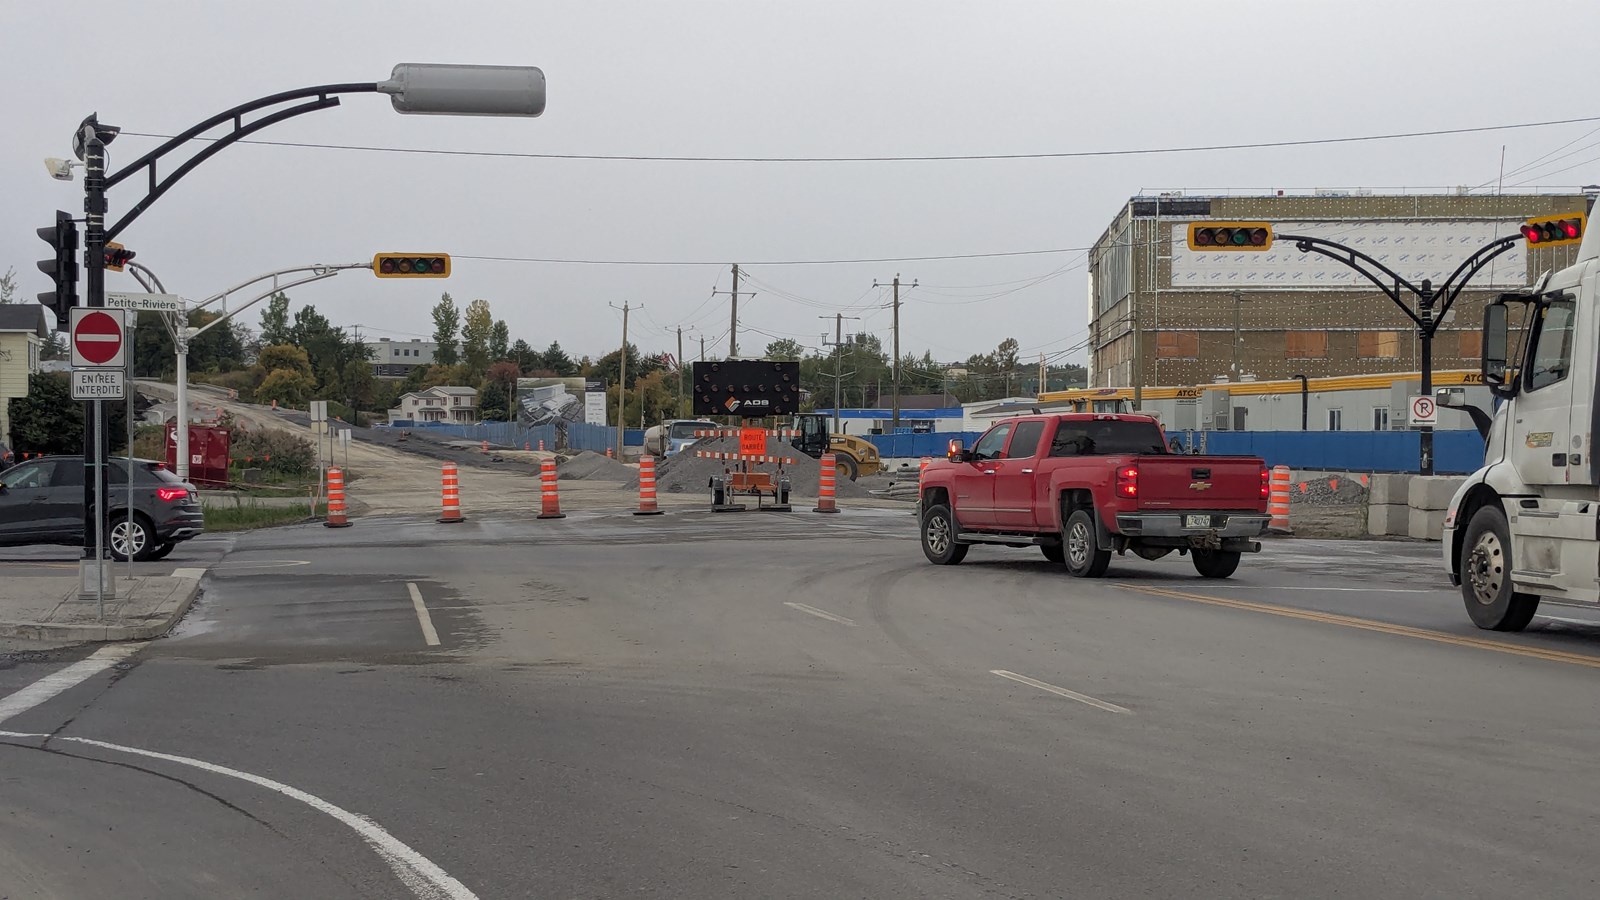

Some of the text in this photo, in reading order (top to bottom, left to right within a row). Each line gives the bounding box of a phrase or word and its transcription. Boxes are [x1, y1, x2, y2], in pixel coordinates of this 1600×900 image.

[107, 297, 177, 310] Petite-Rivière
[81, 373, 116, 384] ENTRÉE
[76, 386, 121, 395] INTERDITE
